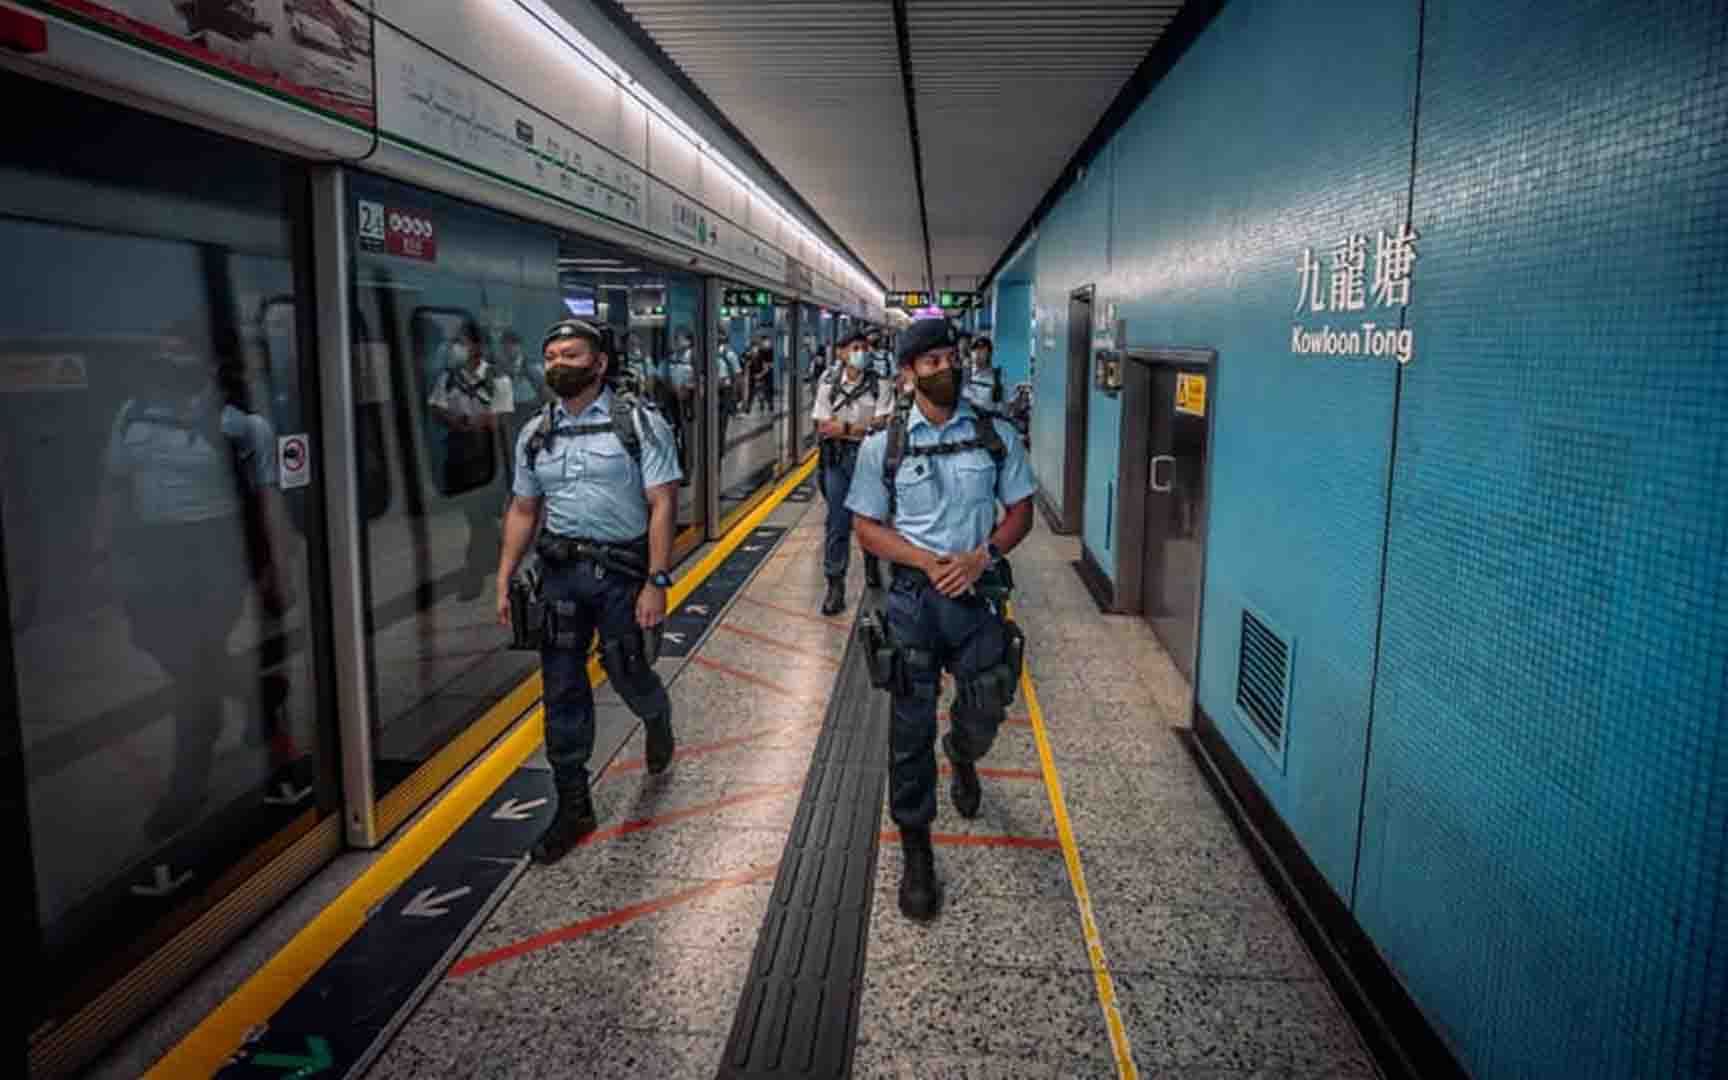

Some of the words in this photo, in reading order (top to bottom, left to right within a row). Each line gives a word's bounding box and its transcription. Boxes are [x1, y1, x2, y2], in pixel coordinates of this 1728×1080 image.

[1295, 224, 1417, 312] 九龍塘
[1292, 325, 1359, 354] Kowloon
[1362, 323, 1413, 363] Tong
